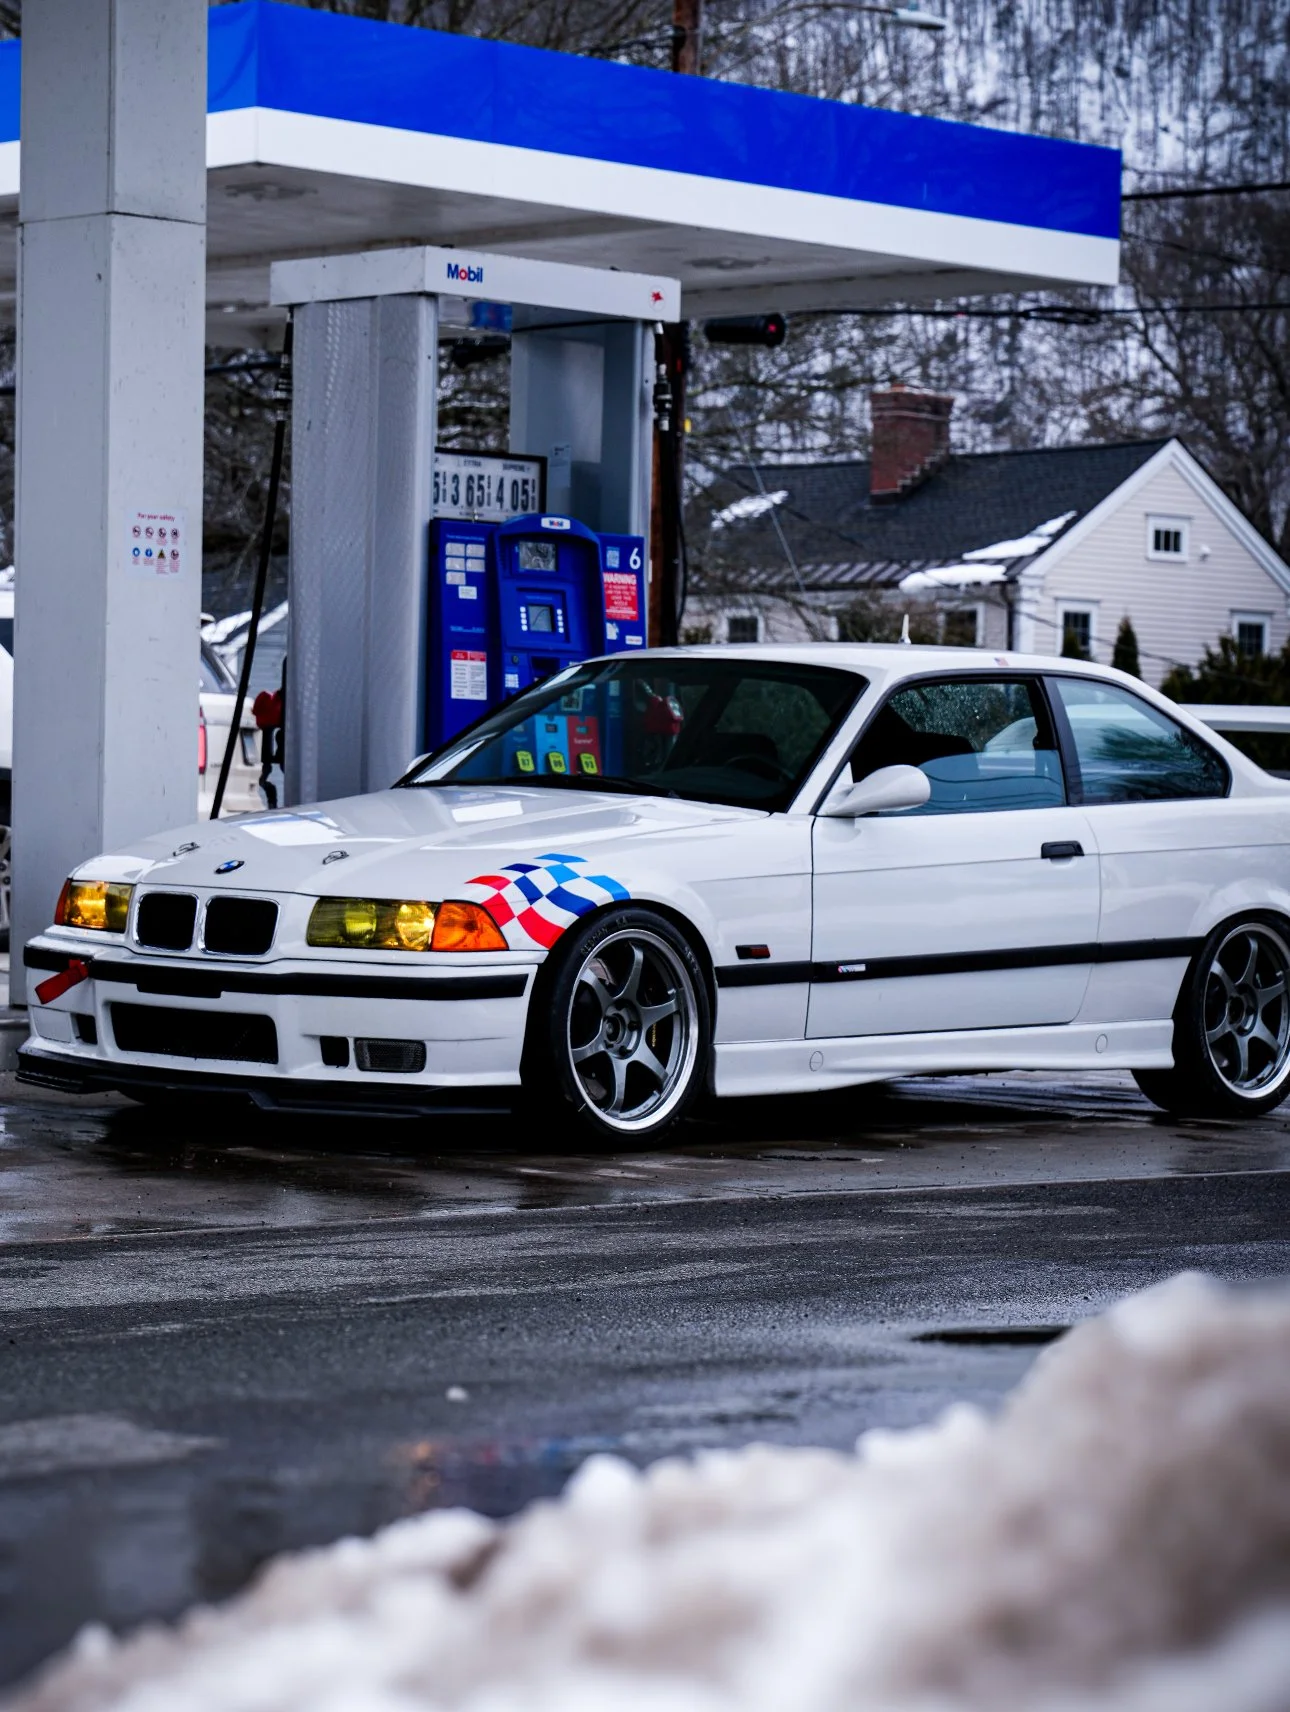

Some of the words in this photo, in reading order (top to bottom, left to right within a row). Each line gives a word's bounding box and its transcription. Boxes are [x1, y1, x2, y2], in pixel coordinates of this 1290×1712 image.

[447, 262, 484, 283] Mobil
[629, 547, 641, 570] 6
[603, 572, 637, 585] WARNING
